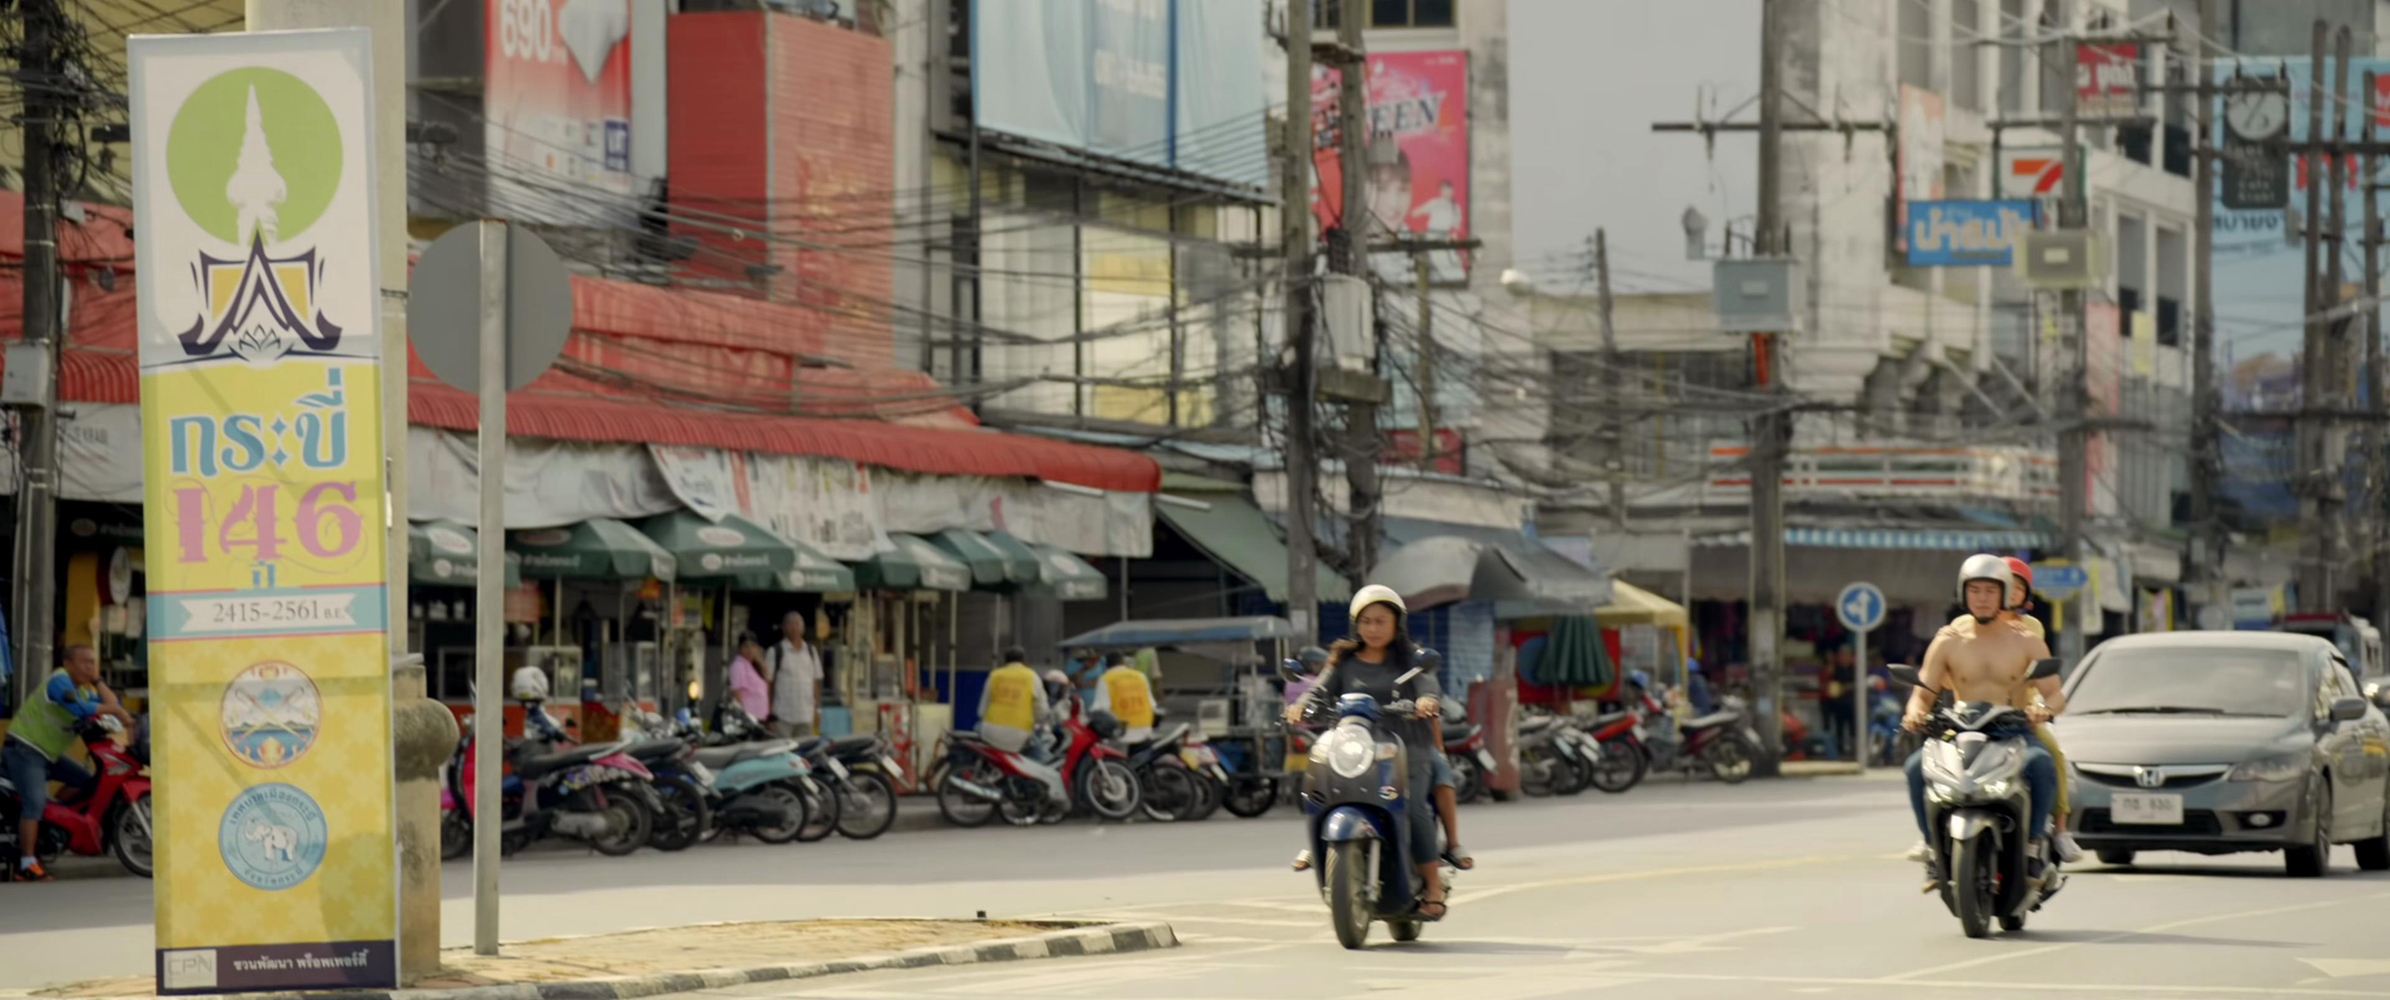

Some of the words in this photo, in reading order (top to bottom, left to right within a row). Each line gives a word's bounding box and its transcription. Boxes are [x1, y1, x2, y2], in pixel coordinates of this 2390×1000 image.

[170, 367, 346, 477] กระบี่
[173, 481, 363, 563] 146
[213, 601, 319, 623] 2415-2561
[167, 957, 213, 974] CPN
